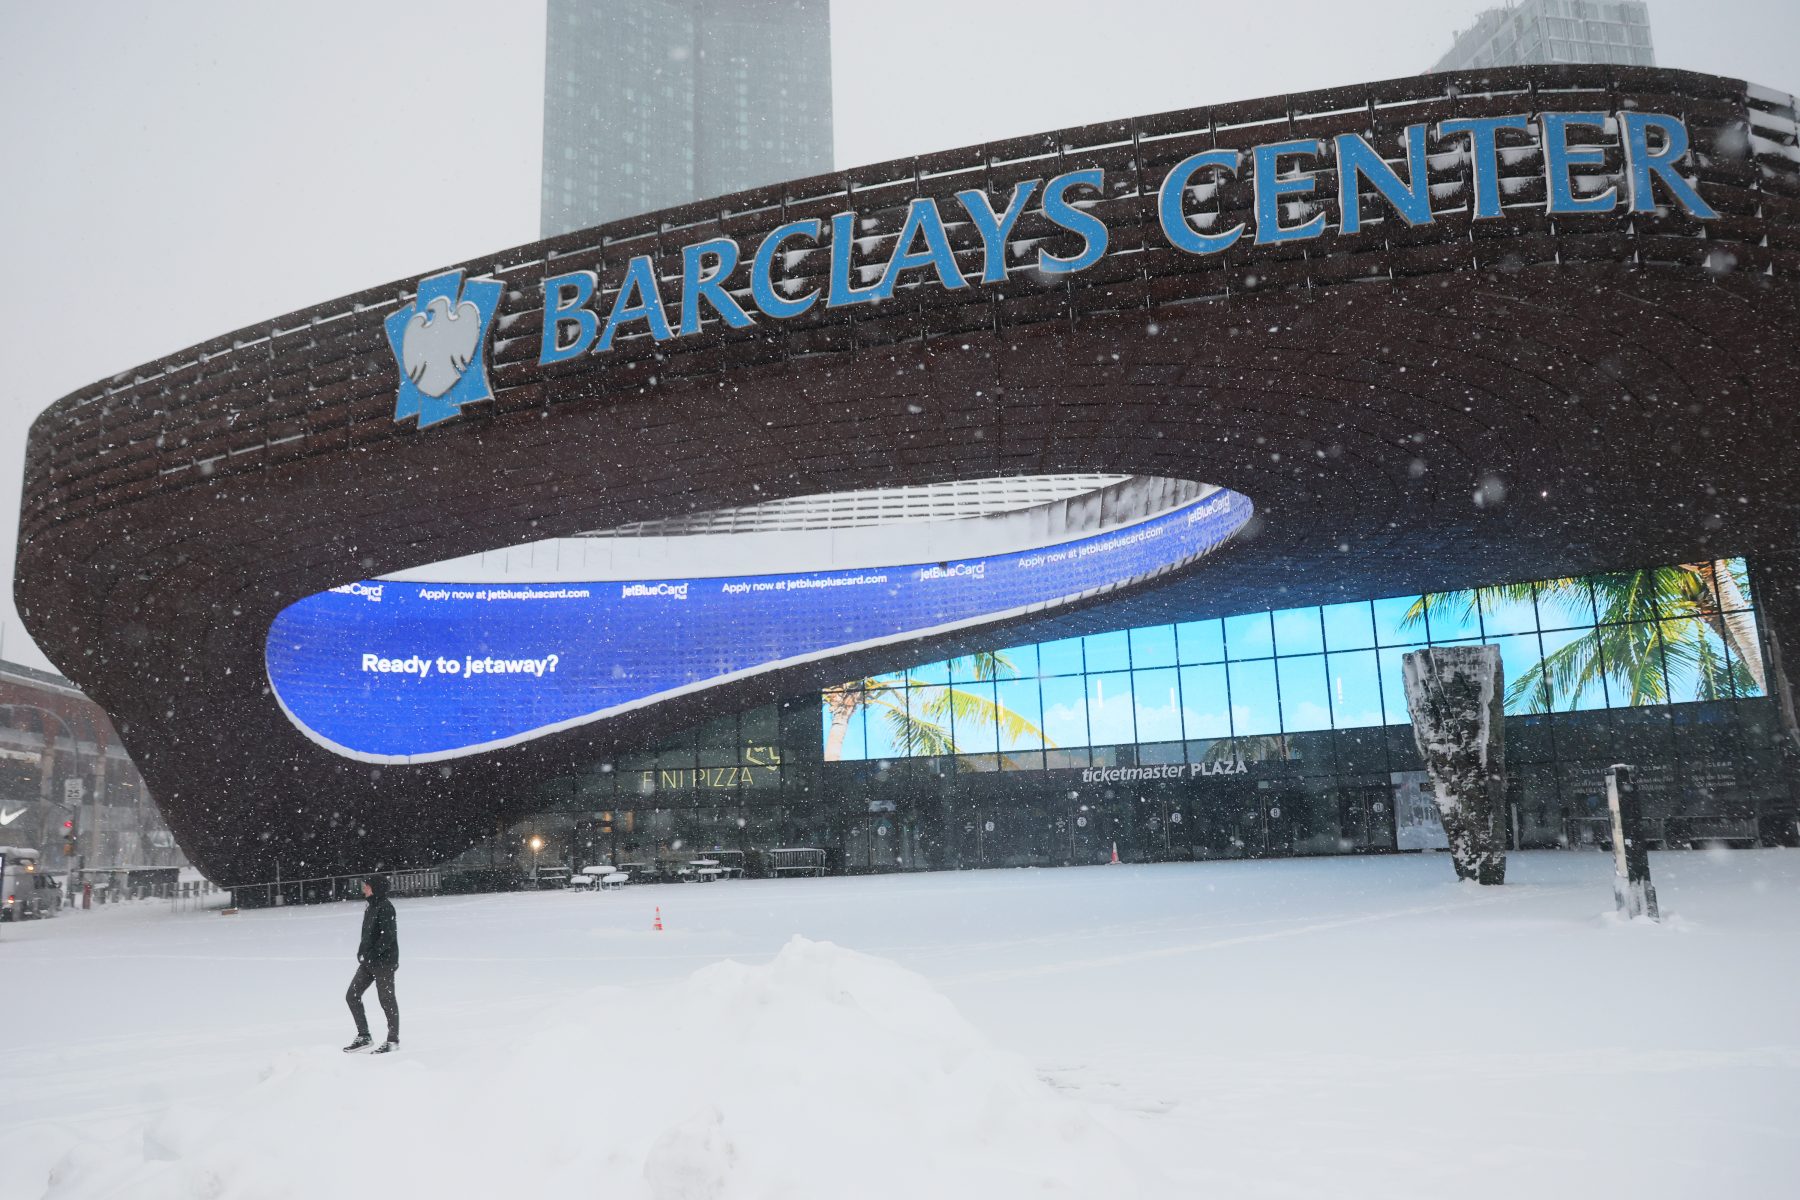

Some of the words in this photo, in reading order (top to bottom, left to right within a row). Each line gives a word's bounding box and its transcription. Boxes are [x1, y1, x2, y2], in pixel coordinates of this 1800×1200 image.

[537, 168, 1109, 366] BARCLAYS
[1158, 110, 1722, 255] CENTER
[1018, 557, 1046, 569] Apply
[1047, 553, 1066, 563] now
[1068, 550, 1078, 559] at
[1078, 526, 1164, 559] jetbluepluscard.com
[419, 588, 450, 600] Apply
[452, 591, 474, 599] now
[476, 590, 486, 599] at
[487, 588, 590, 601] jetbluepluscard.com
[722, 581, 751, 594] Apply
[752, 582, 774, 591] now
[775, 581, 785, 590] at
[786, 574, 887, 592] jetbluepluscard.com
[362, 653, 432, 678] Ready
[436, 656, 460, 674] to
[463, 654, 559, 679] jetaway?
[643, 769, 684, 789] FNI
[692, 767, 754, 788] PIZZA
[1081, 763, 1186, 784] ticketmaster
[1190, 760, 1248, 777] PLAZA
